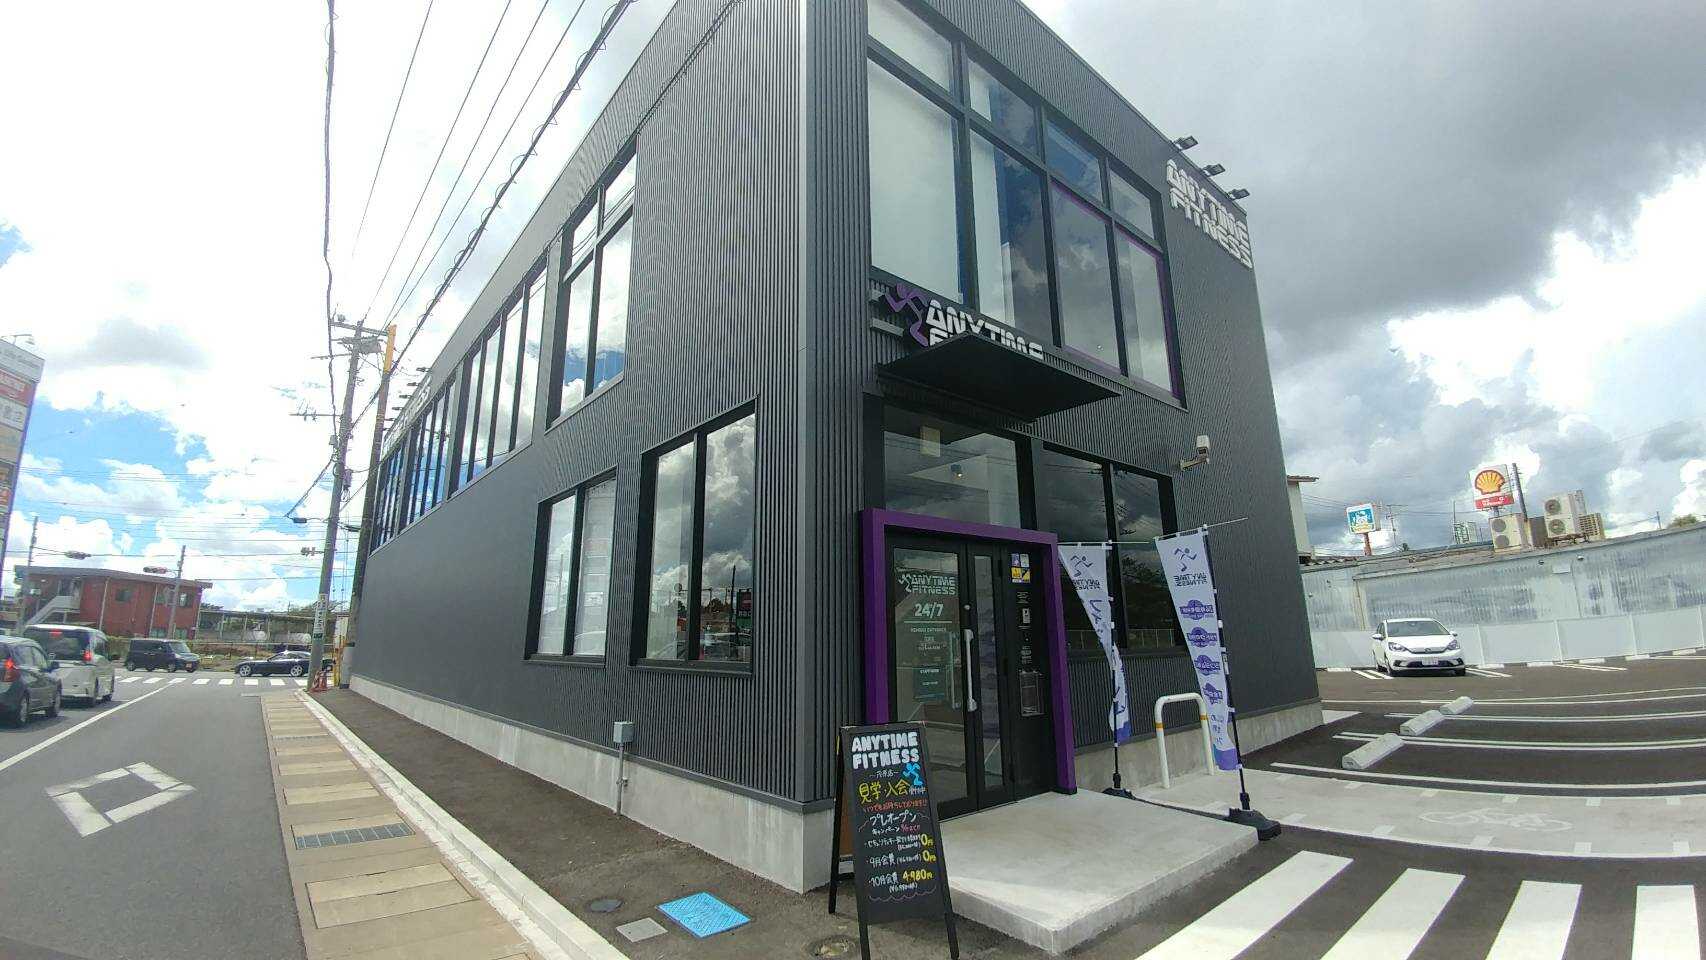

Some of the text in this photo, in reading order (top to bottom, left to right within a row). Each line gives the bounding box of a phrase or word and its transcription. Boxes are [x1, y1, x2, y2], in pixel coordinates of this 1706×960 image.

[1167, 159, 1250, 252] ANYTIME
[1170, 188, 1252, 268] FITNESS
[926, 299, 1043, 361] ANYTIME
[911, 574, 956, 586] ANYTIME
[912, 585, 956, 595] FITNESS
[914, 602, 944, 618] 24/7
[852, 731, 919, 752] ANYTIME
[852, 748, 921, 769] FITNESS
[869, 809, 917, 826] プレオープン
